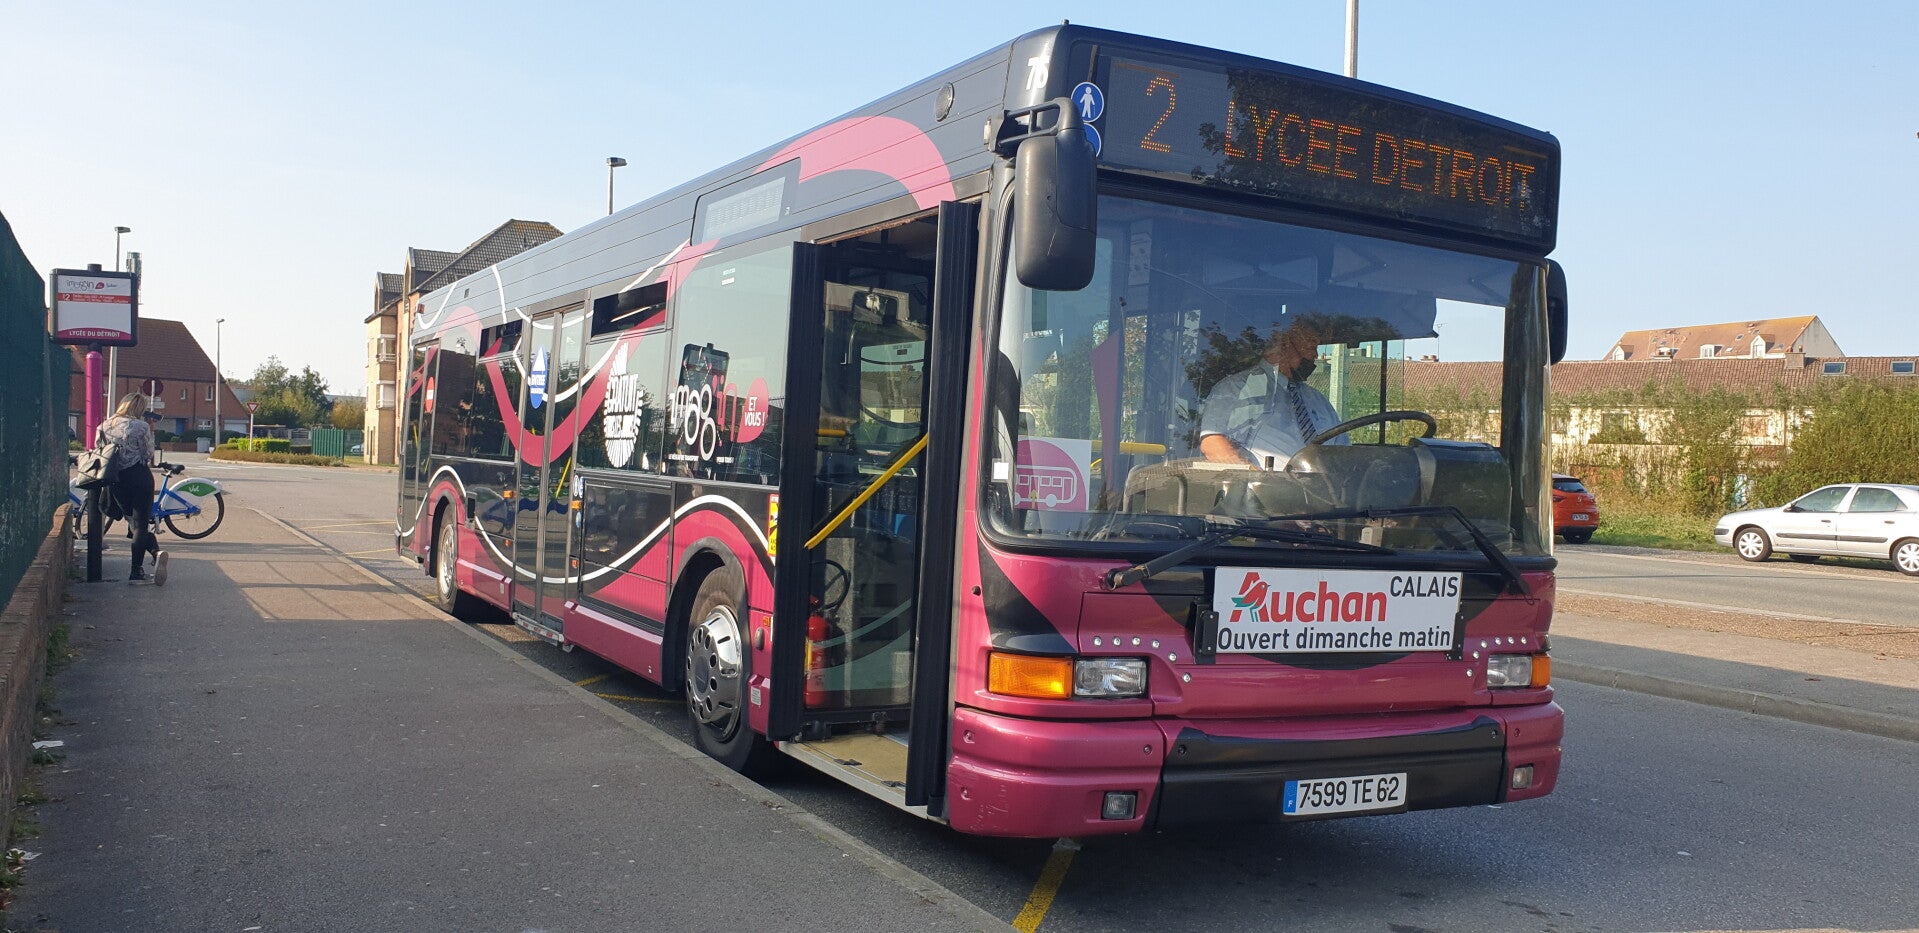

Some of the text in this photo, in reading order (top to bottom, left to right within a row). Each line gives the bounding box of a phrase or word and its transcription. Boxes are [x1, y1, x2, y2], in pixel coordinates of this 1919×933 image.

[1141, 77, 1535, 212] 2 LYCEE DETROIT
[69, 329, 85, 337] LYCÉE
[97, 330, 120, 338] DÉTROIT
[748, 397, 758, 411] ET
[745, 411, 761, 427] VOUS
[1229, 571, 1388, 623] Auchan
[1390, 576, 1459, 598] CALAIS
[1217, 625, 1451, 650] Ouvert dimanche matin
[1299, 776, 1400, 808] 7599 TE 62
[1287, 800, 1293, 808] F
